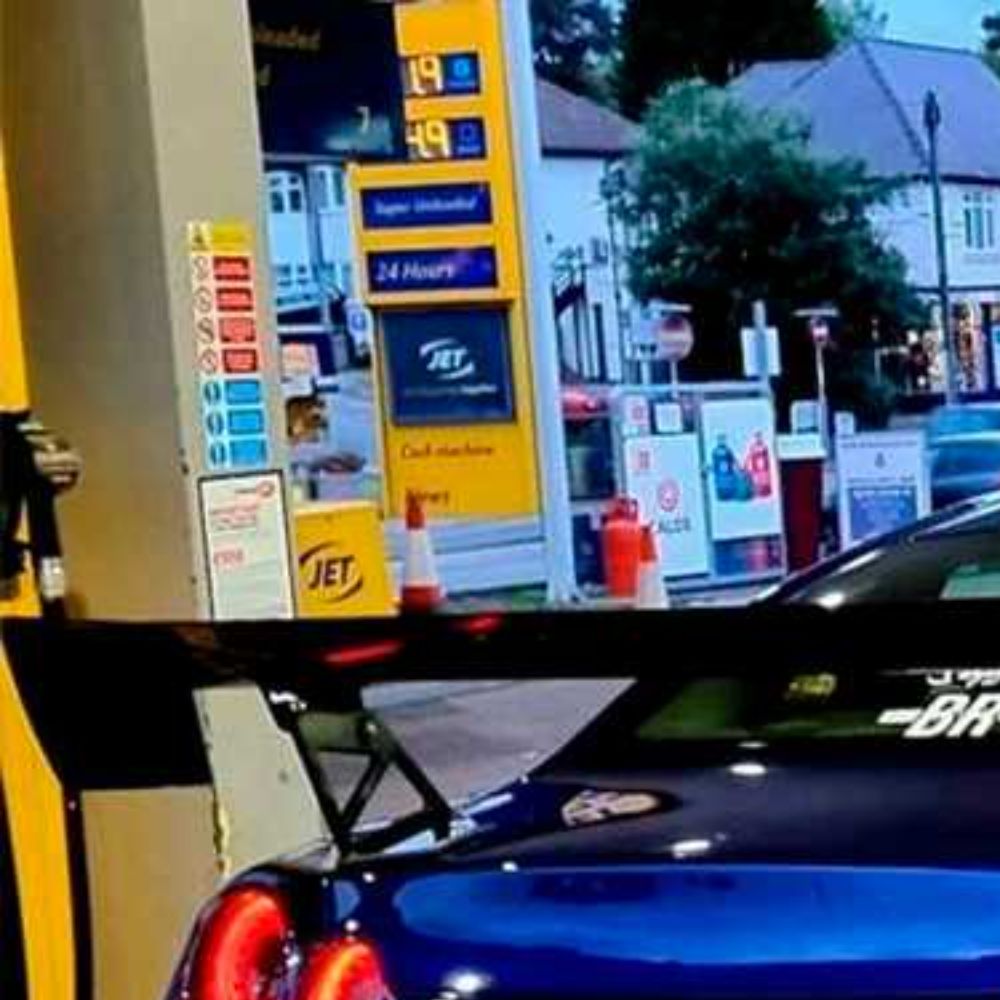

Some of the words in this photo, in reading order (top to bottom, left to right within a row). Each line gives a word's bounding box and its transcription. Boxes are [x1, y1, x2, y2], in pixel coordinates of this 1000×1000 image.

[376, 261, 399, 282] 24
[402, 260, 456, 281] Hours
[427, 347, 467, 371] JET
[308, 554, 355, 590] JET
